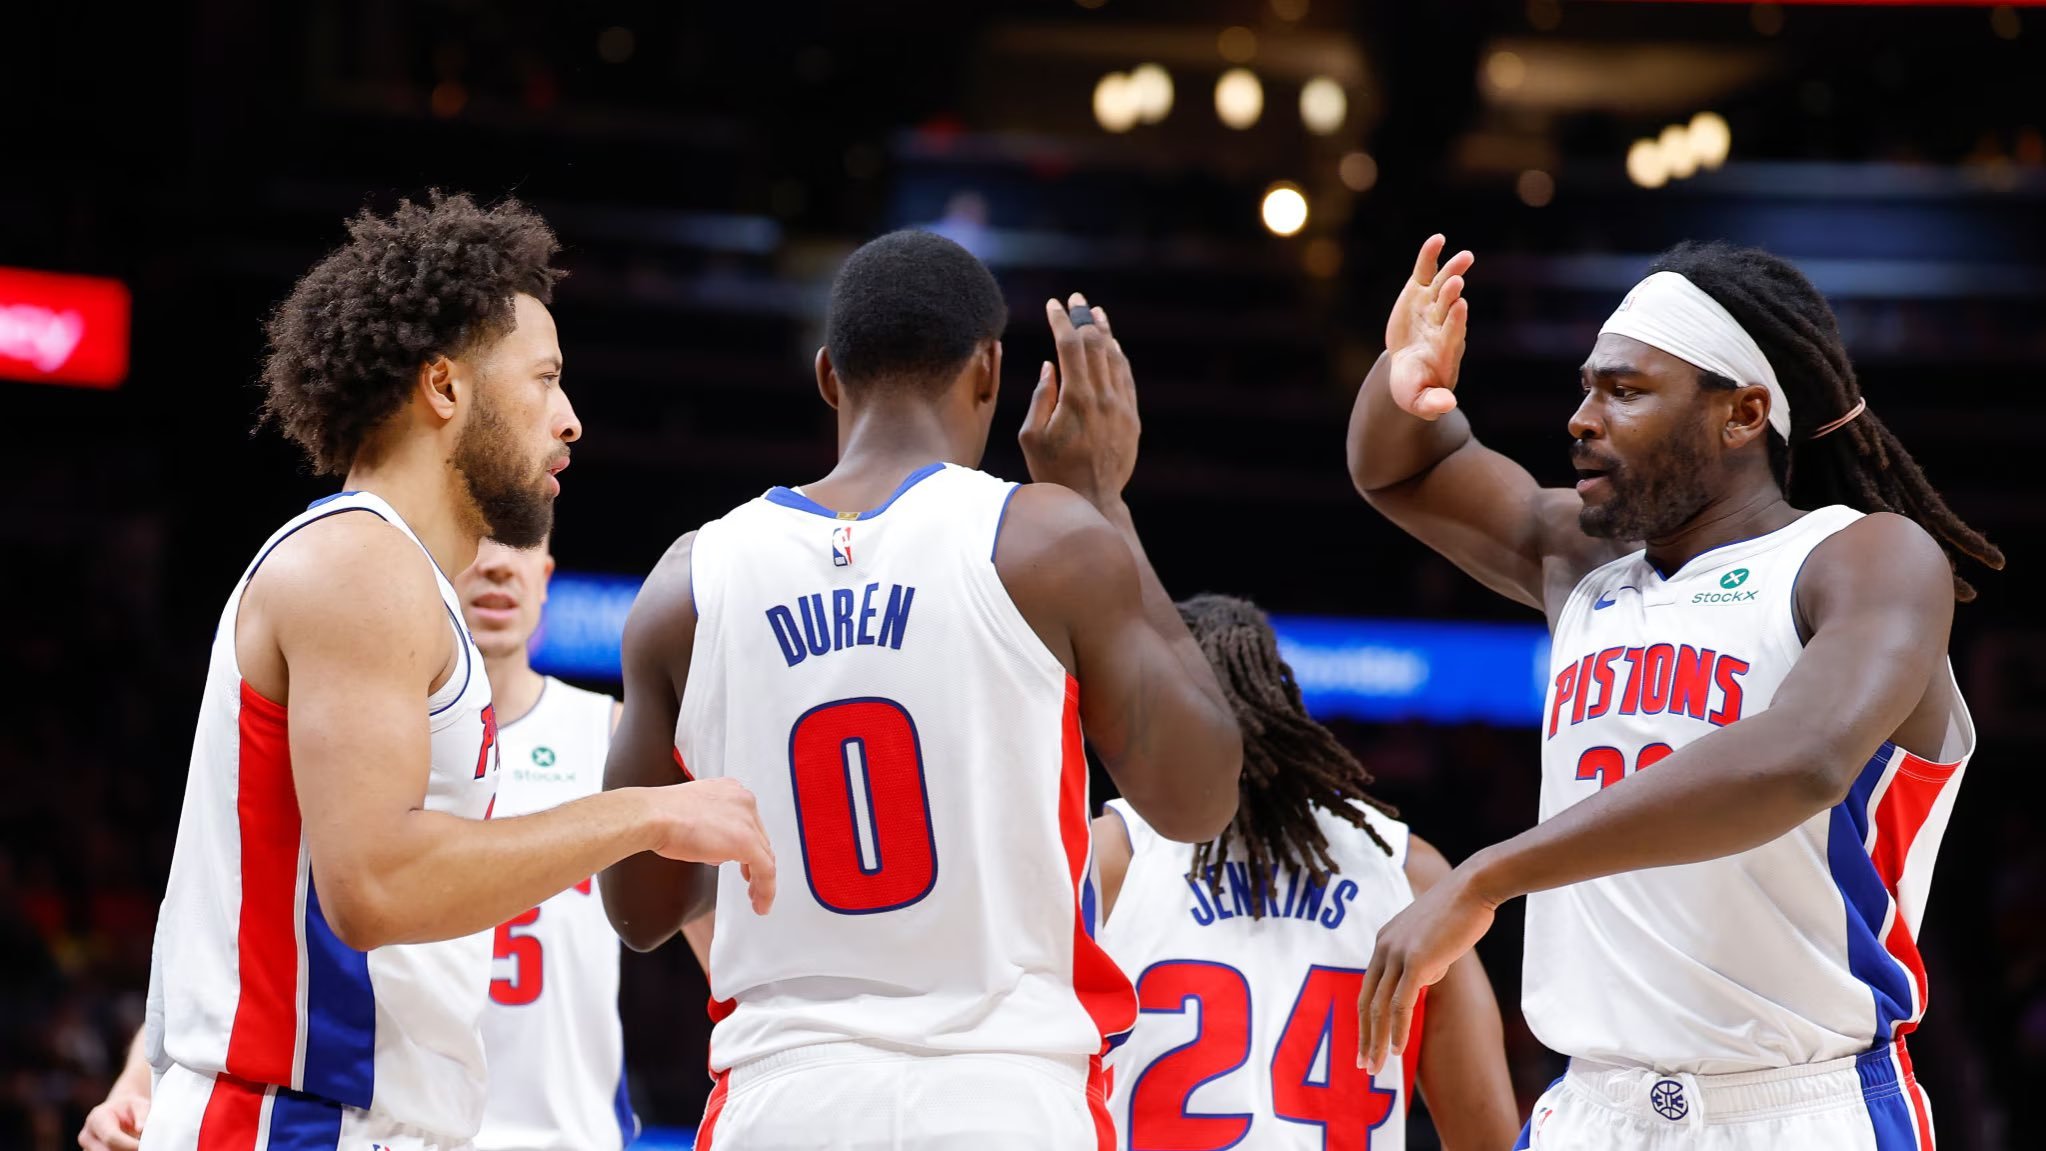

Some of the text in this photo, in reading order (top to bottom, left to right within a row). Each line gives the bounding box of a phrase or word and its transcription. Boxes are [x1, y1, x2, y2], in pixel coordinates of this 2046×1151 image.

[765, 582, 915, 667] DUREN
[1548, 643, 1750, 740] PISTONS
[788, 697, 938, 915] 0
[1127, 959, 1397, 1151] 24
